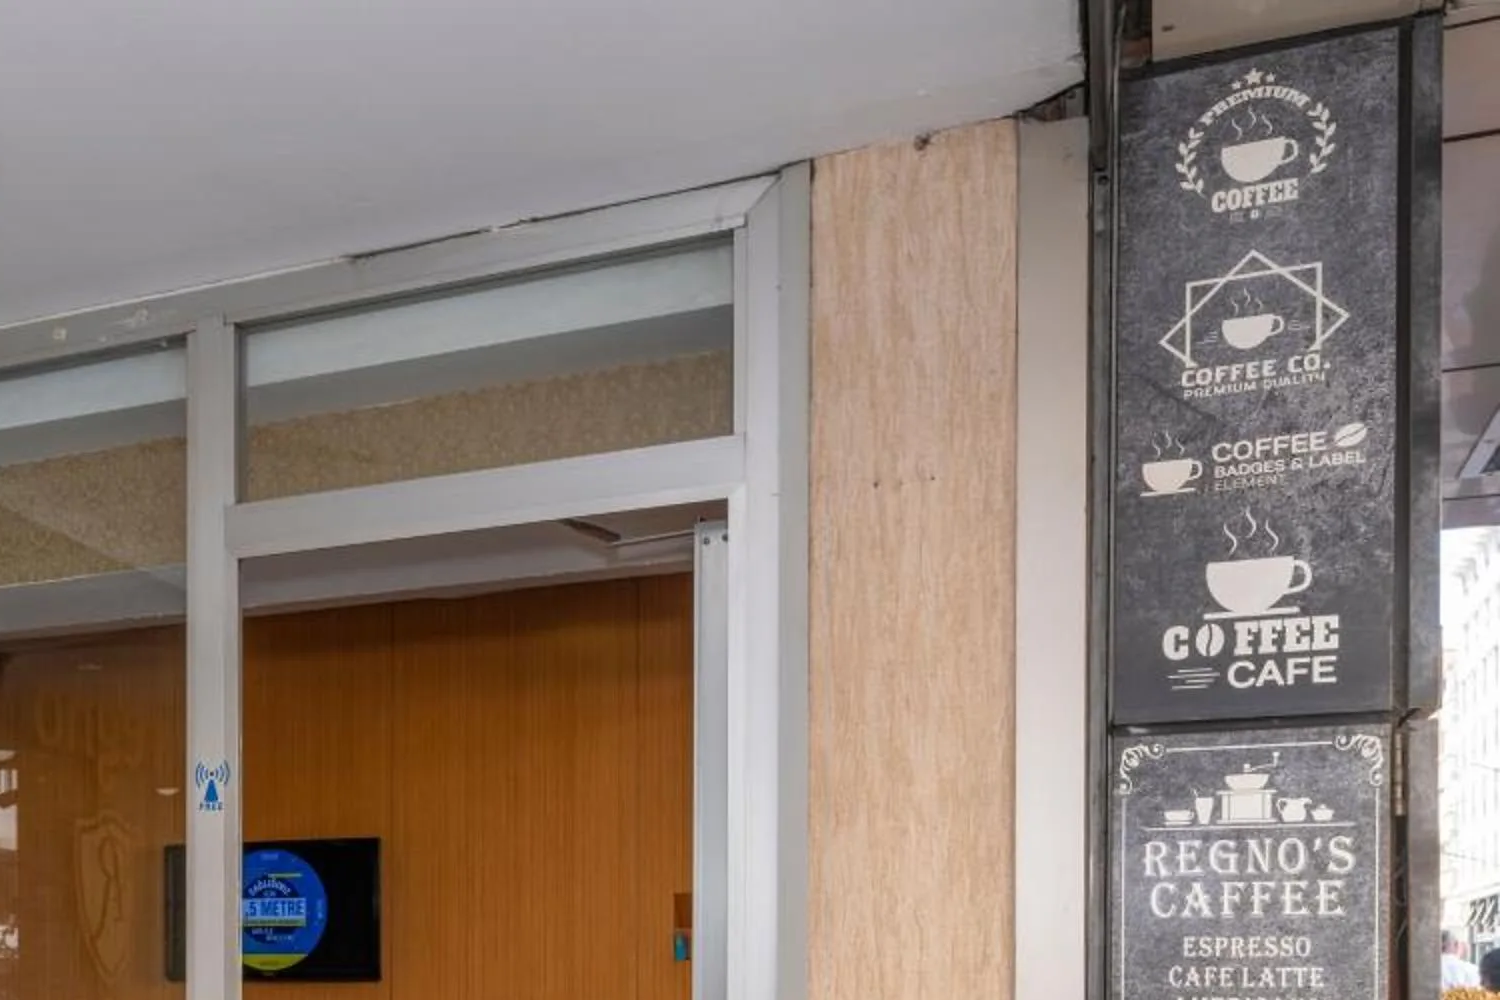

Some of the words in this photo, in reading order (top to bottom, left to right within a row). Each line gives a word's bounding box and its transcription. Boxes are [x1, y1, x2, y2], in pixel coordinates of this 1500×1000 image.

[1200, 85, 1311, 126] PREMIUM
[1211, 178, 1299, 213] COFFEE
[1181, 359, 1277, 387] COFFEE
[1288, 354, 1331, 373] CO.
[1183, 382, 1257, 399] PREMIUM
[1212, 431, 1328, 462] COFFEE
[1214, 459, 1285, 479] BADGES
[1309, 451, 1367, 468] LABEL
[1227, 655, 1338, 688] CAFE
[1143, 836, 1357, 878] REGNO'S
[1150, 879, 1347, 918] CAFFEE
[1182, 936, 1312, 958] ESPRESSO
[1168, 965, 1235, 988] CAFE
[1242, 966, 1325, 989] LATTE
